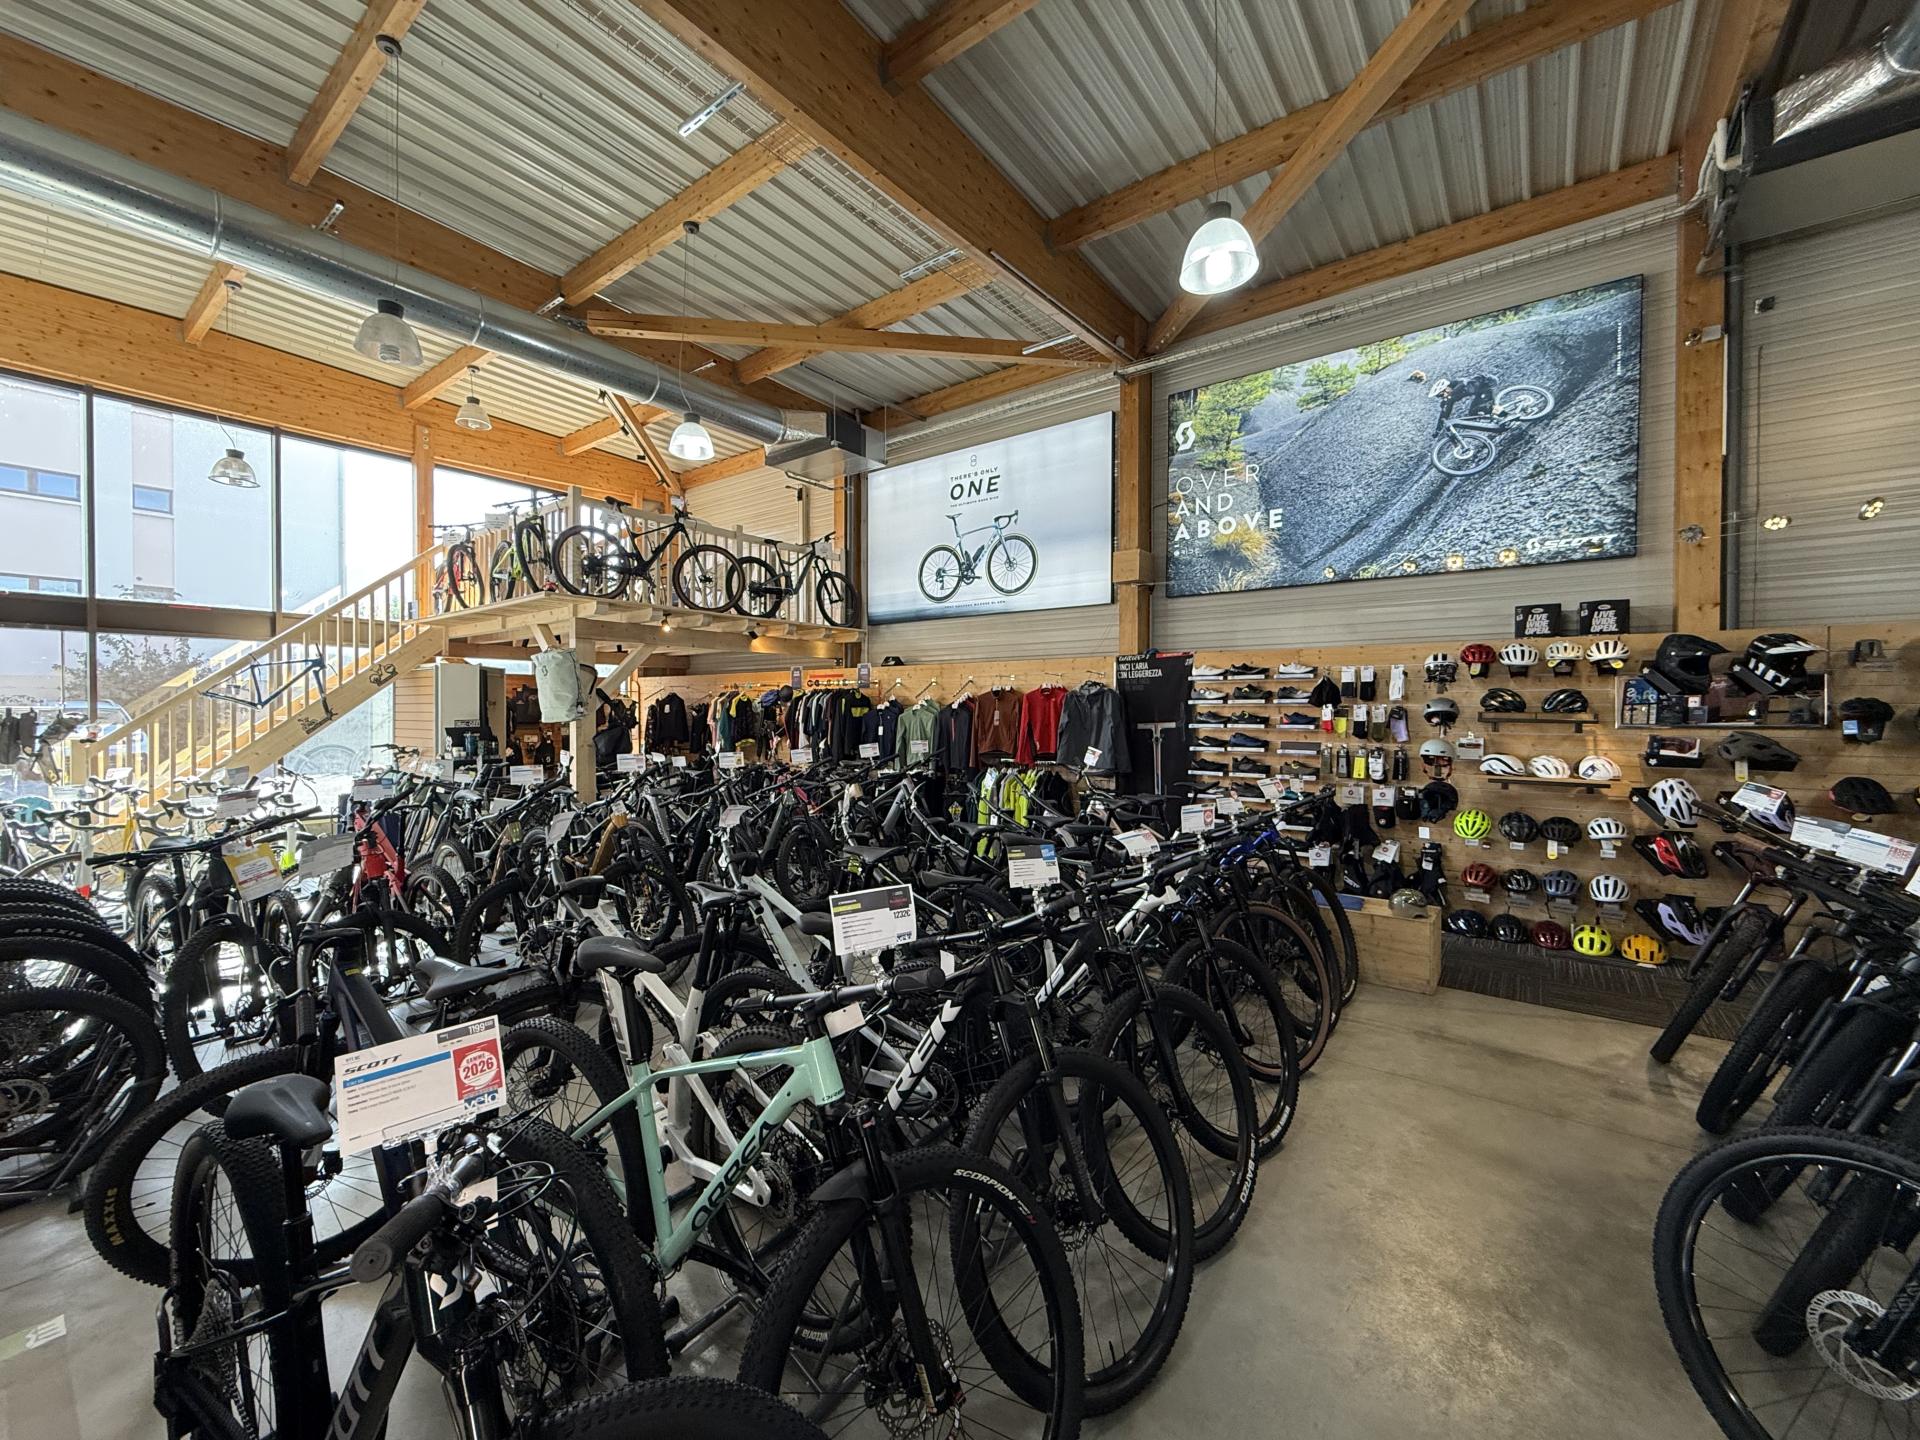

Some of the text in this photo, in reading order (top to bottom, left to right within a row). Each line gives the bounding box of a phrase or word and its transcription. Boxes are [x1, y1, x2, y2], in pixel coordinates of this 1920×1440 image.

[950, 466, 998, 482] THERE'S ONLY
[1176, 464, 1260, 495] OVER
[950, 474, 1001, 501] ONE
[1175, 493, 1234, 517] AND
[1174, 508, 1284, 542] ABOVE
[1541, 534, 1619, 549] SCOTT
[1526, 620, 1550, 628] WIDE
[1528, 613, 1549, 621] LIVE
[1591, 617, 1617, 625] WIDE
[1594, 610, 1617, 618] LIVE
[1128, 669, 1163, 679] LEGGEREZZA
[468, 1023, 486, 1036] 1199
[343, 1054, 402, 1076] SCOTT
[884, 999, 962, 1112] REK
[462, 1058, 494, 1080] 2026
[953, 1168, 1017, 1201] SCORPION
[1240, 1159, 1255, 1204] BARZO
